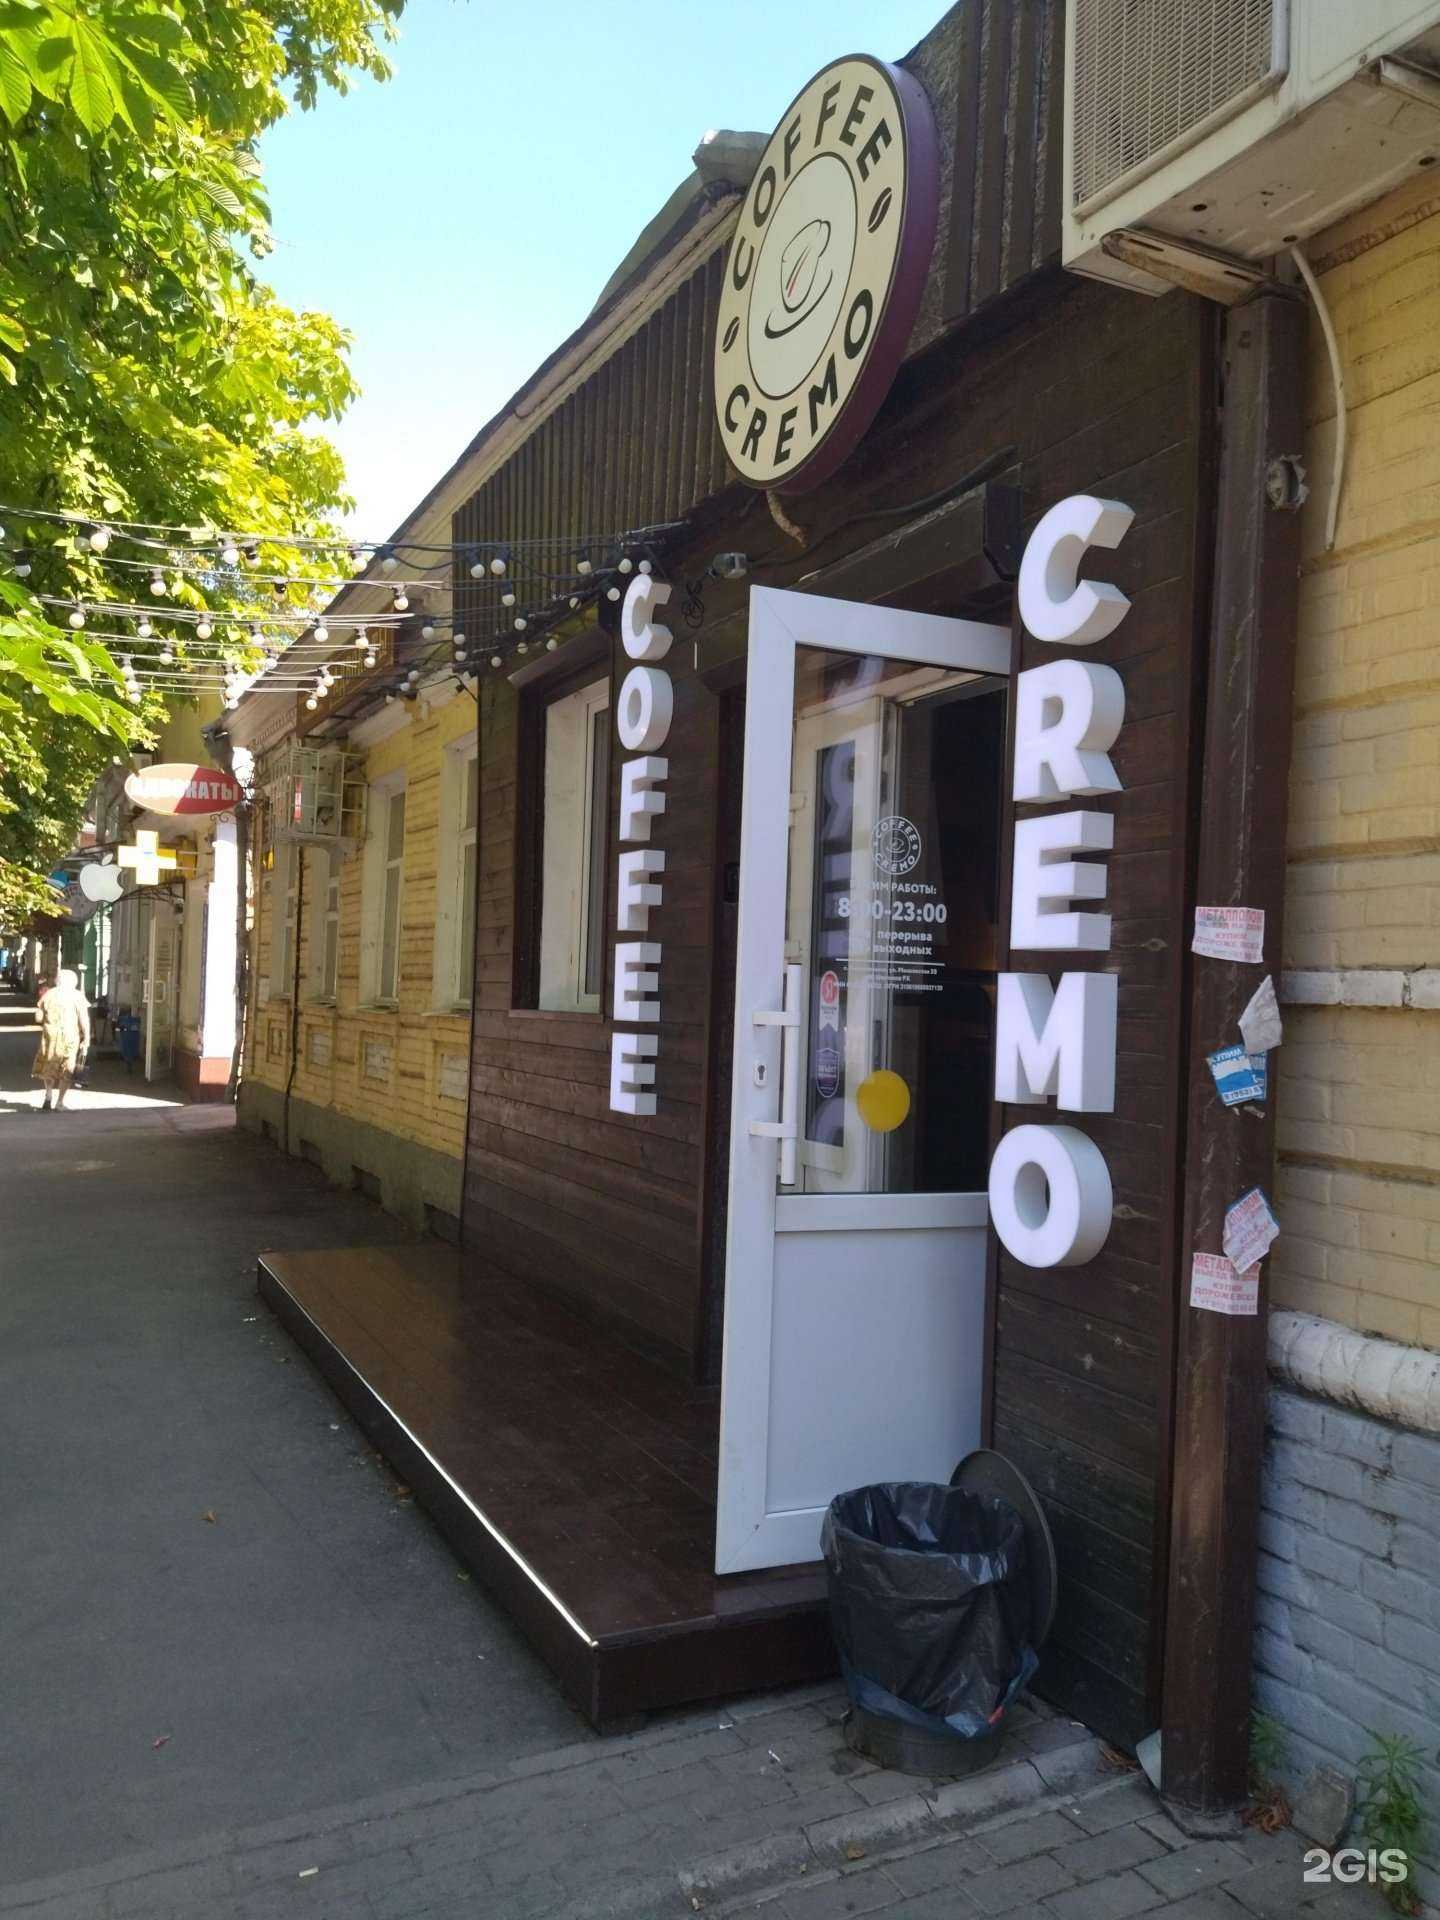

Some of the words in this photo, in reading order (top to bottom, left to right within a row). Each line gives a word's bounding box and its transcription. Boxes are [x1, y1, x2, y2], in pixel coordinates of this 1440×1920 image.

[733, 80, 893, 291] COFFEE
[724, 288, 873, 466] CREMO
[130, 778, 239, 801] КАТЫ
[875, 820, 918, 842] COFFEE
[609, 573, 674, 1116] COFFEE
[875, 853, 916, 872] CREMO
[891, 881, 937, 895] РАБОТЫ:
[988, 494, 1136, 1268] CREMO
[838, 897, 948, 923] 800-23:00
